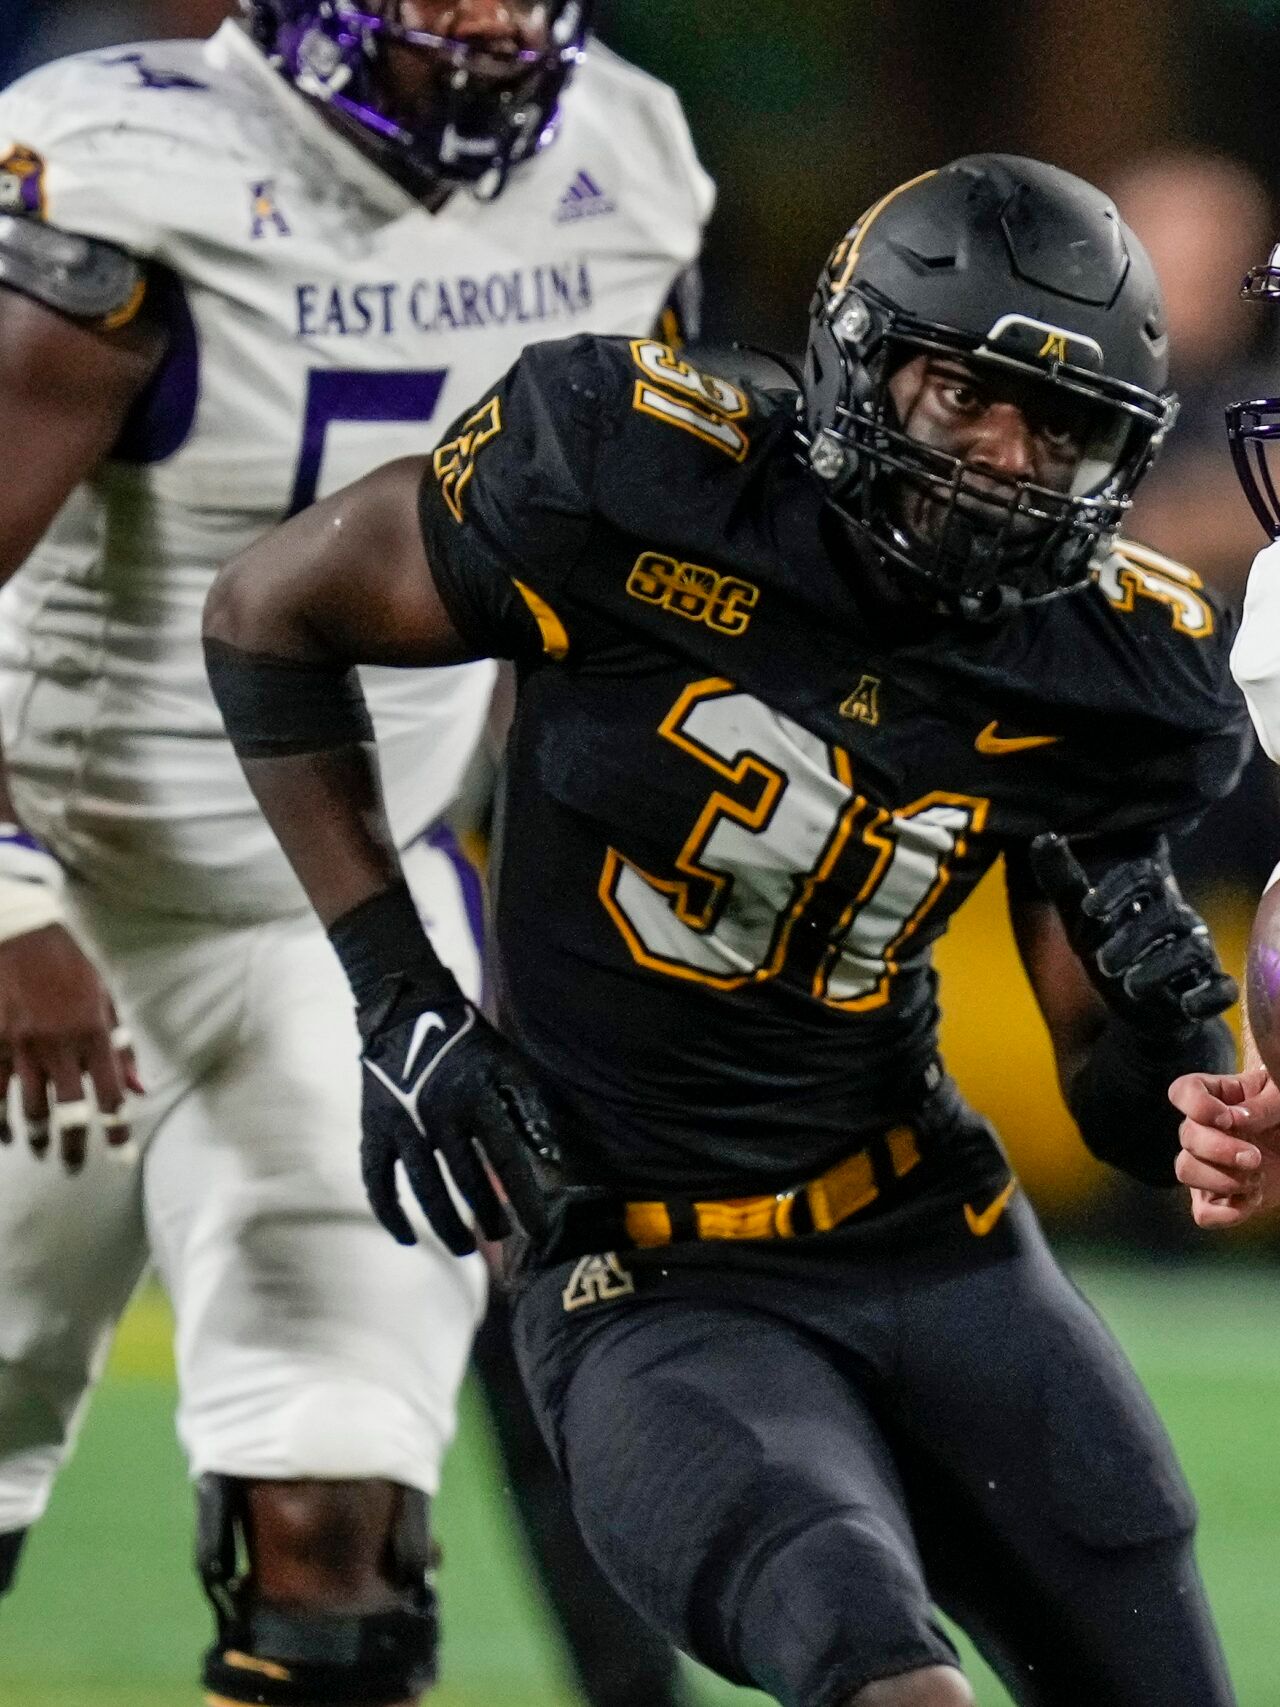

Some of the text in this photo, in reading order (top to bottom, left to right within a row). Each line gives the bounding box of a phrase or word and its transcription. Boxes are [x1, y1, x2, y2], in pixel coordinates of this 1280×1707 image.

[296, 264, 592, 336] EAST CAROLINA
[599, 677, 990, 1011] 31
